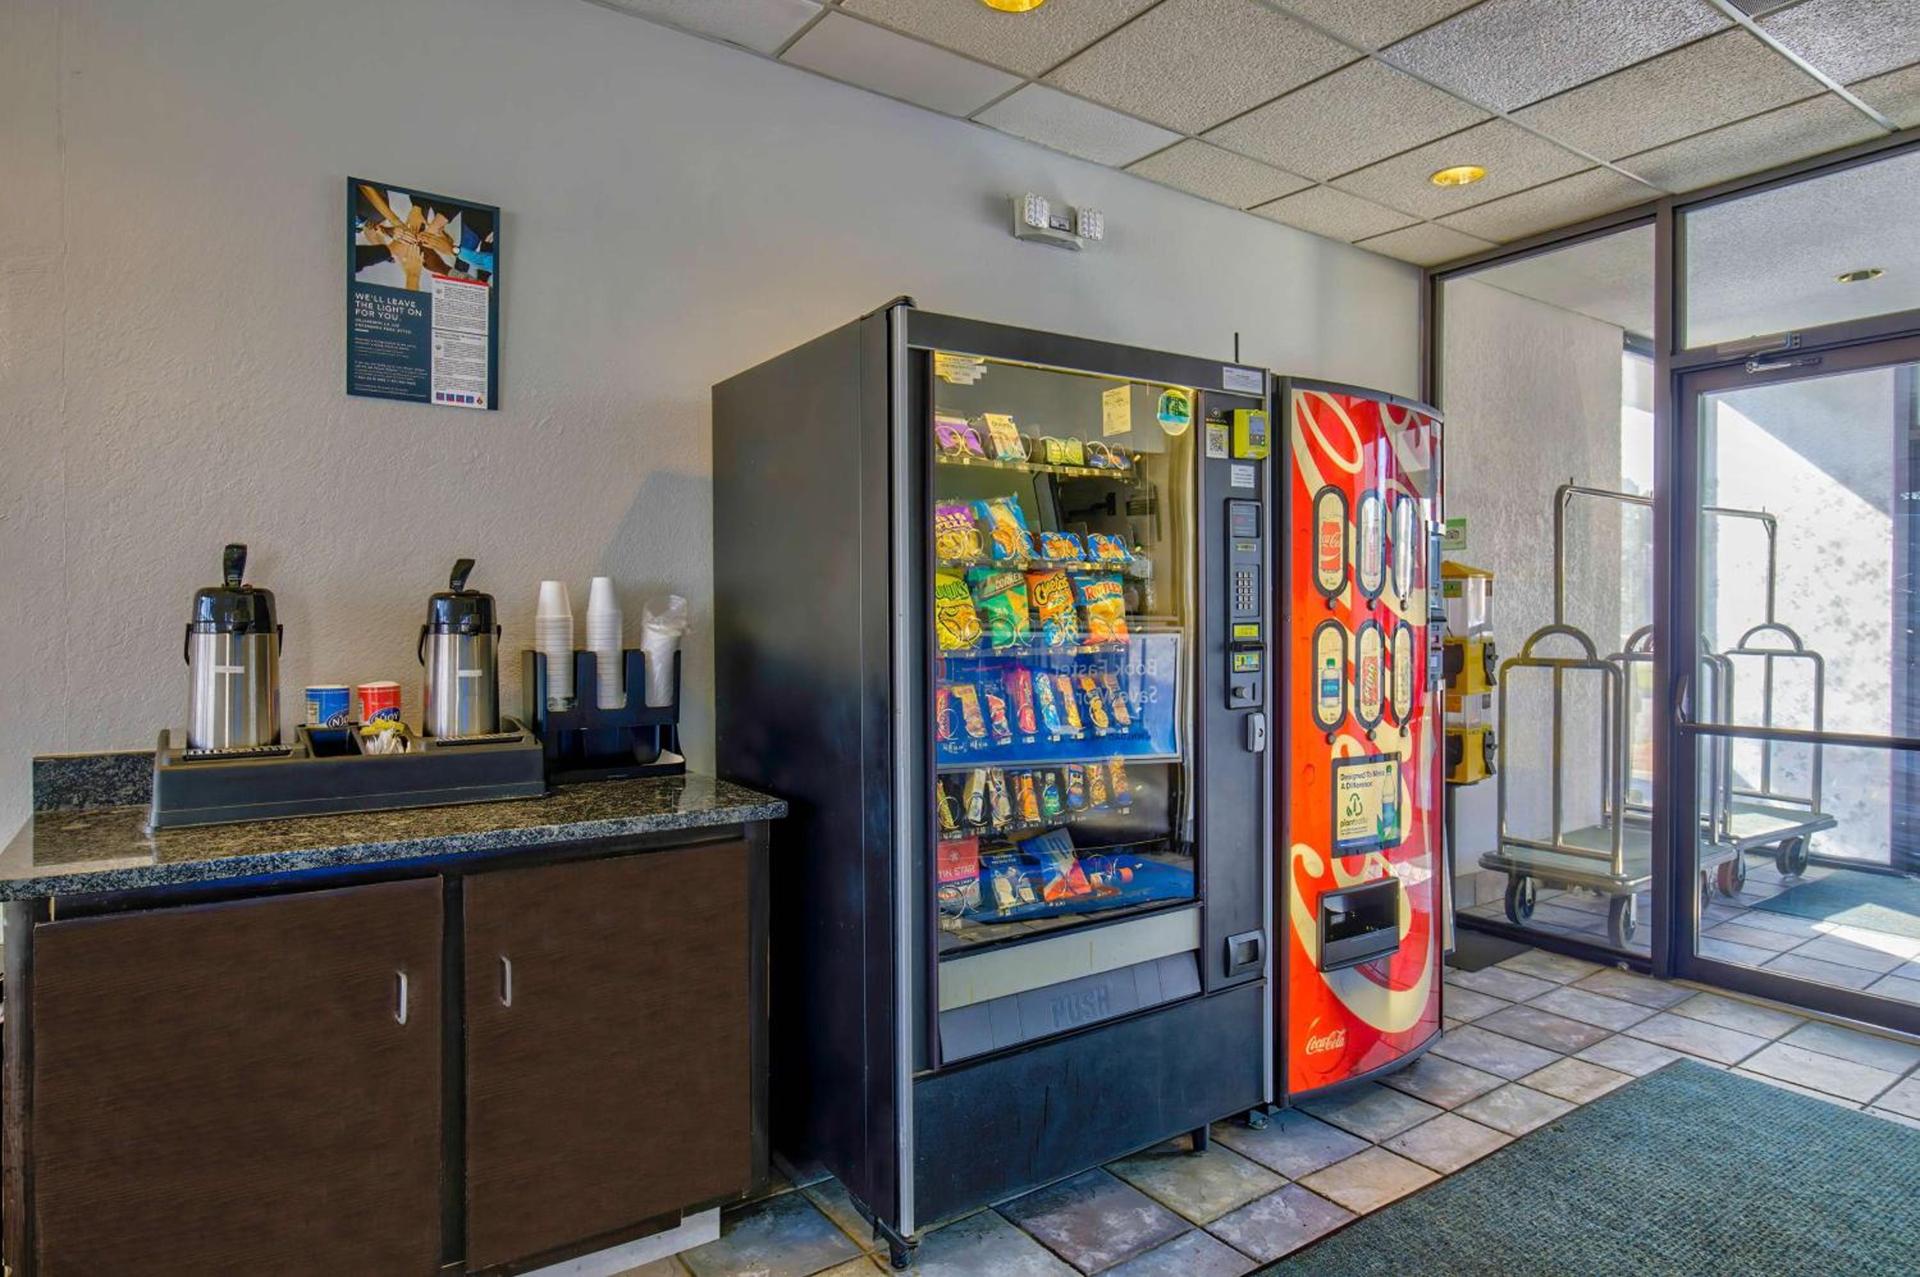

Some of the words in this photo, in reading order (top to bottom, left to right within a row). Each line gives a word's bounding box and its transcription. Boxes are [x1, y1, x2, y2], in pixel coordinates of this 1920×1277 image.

[355, 292, 384, 304] WE'LL
[387, 297, 416, 308] LEAVE
[355, 308, 374, 317] FOR
[378, 311, 399, 321] YOU
[356, 300, 373, 310] THE
[377, 303, 404, 315] LIGHT
[407, 308, 422, 317] ON
[1049, 984, 1110, 1027] PUSH
